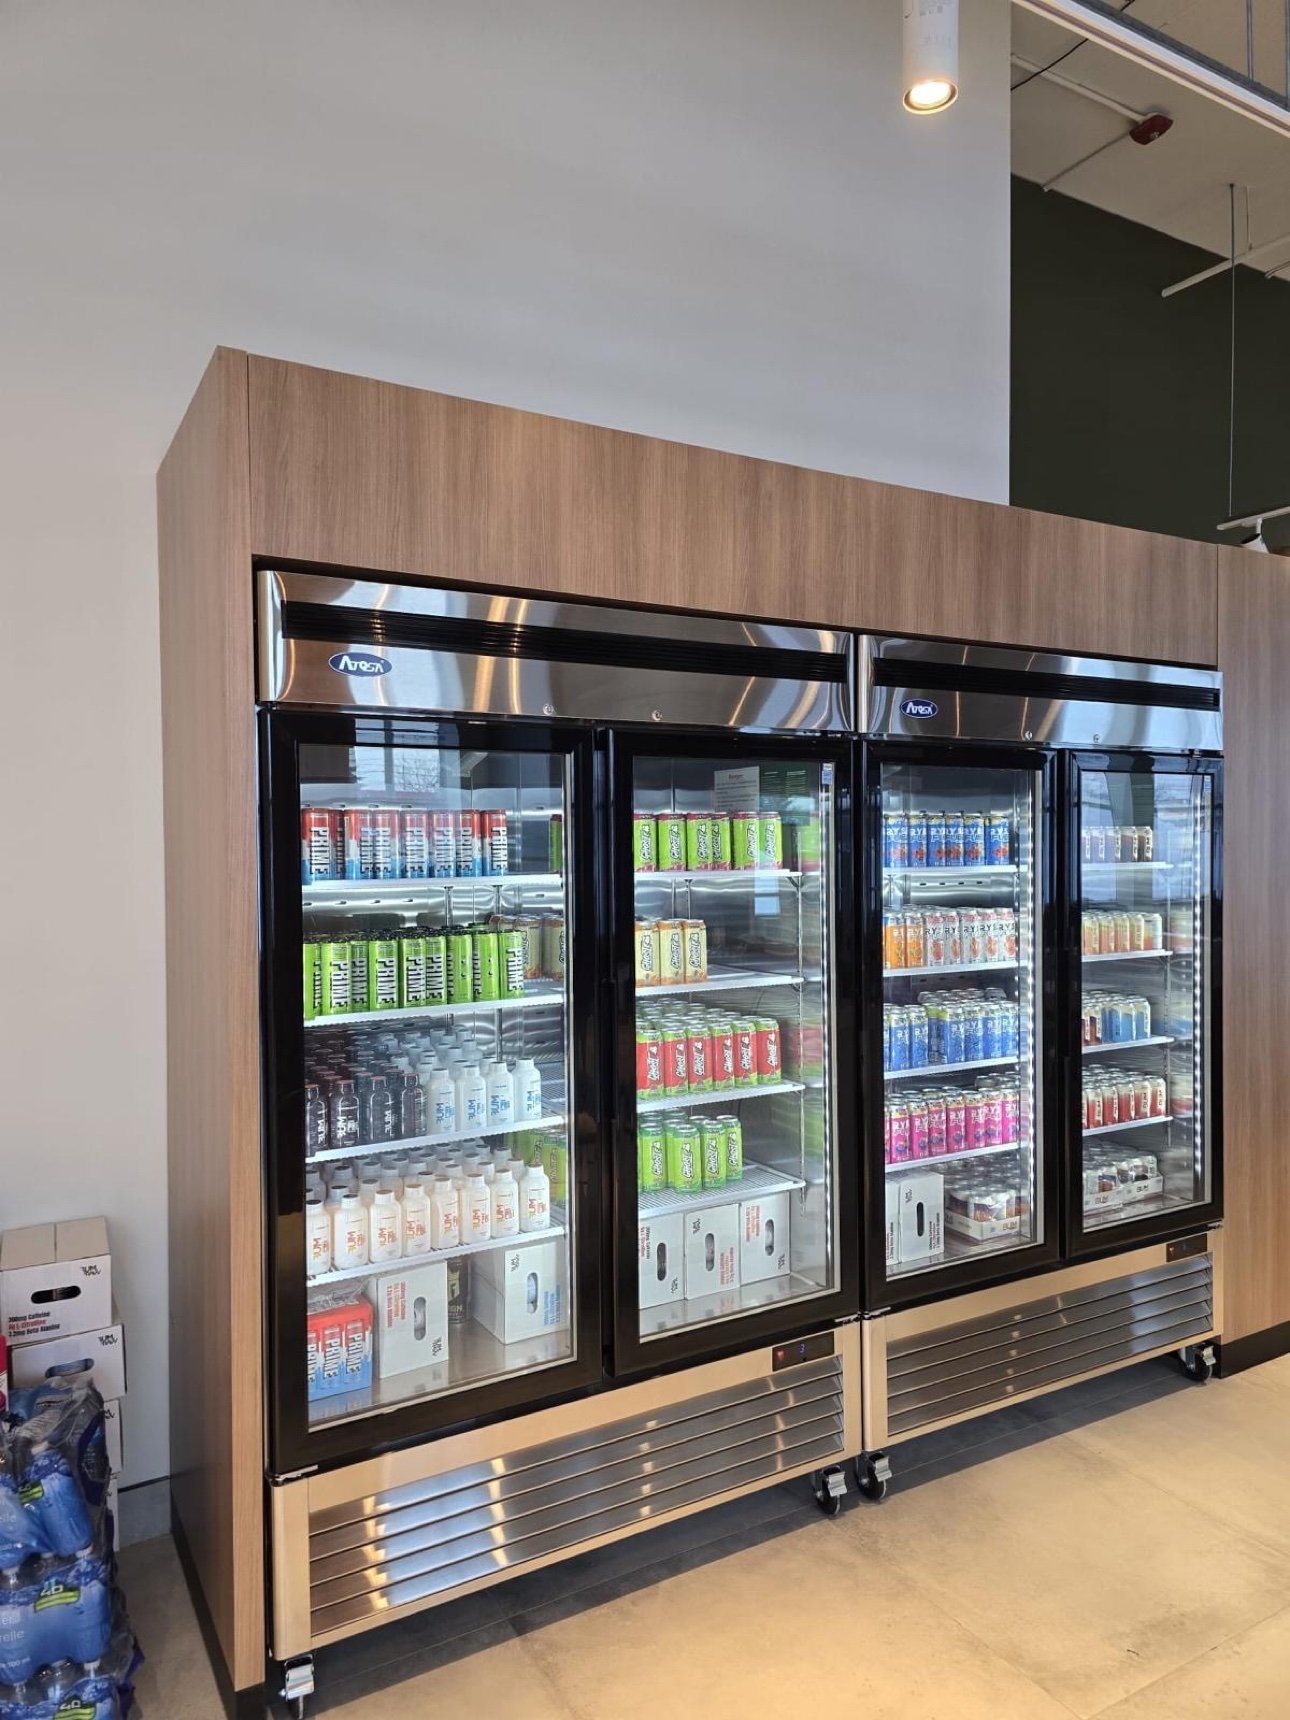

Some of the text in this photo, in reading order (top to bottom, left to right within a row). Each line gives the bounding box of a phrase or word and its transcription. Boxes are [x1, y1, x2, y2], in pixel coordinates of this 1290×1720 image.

[338, 655, 384, 673] ATOSA
[310, 827, 329, 875] PRIME
[405, 827, 424, 873] PRIME
[436, 827, 455, 872] PRIME
[491, 827, 507, 872] PRIME
[330, 961, 348, 1008] PRIME
[377, 958, 395, 1004] PRIME
[407, 956, 425, 1001] PRIME
[426, 955, 443, 1001] PRIME
[506, 948, 525, 992] PRIME
[324, 1339, 341, 1380] PRIME
[346, 1333, 363, 1374] PRIME
